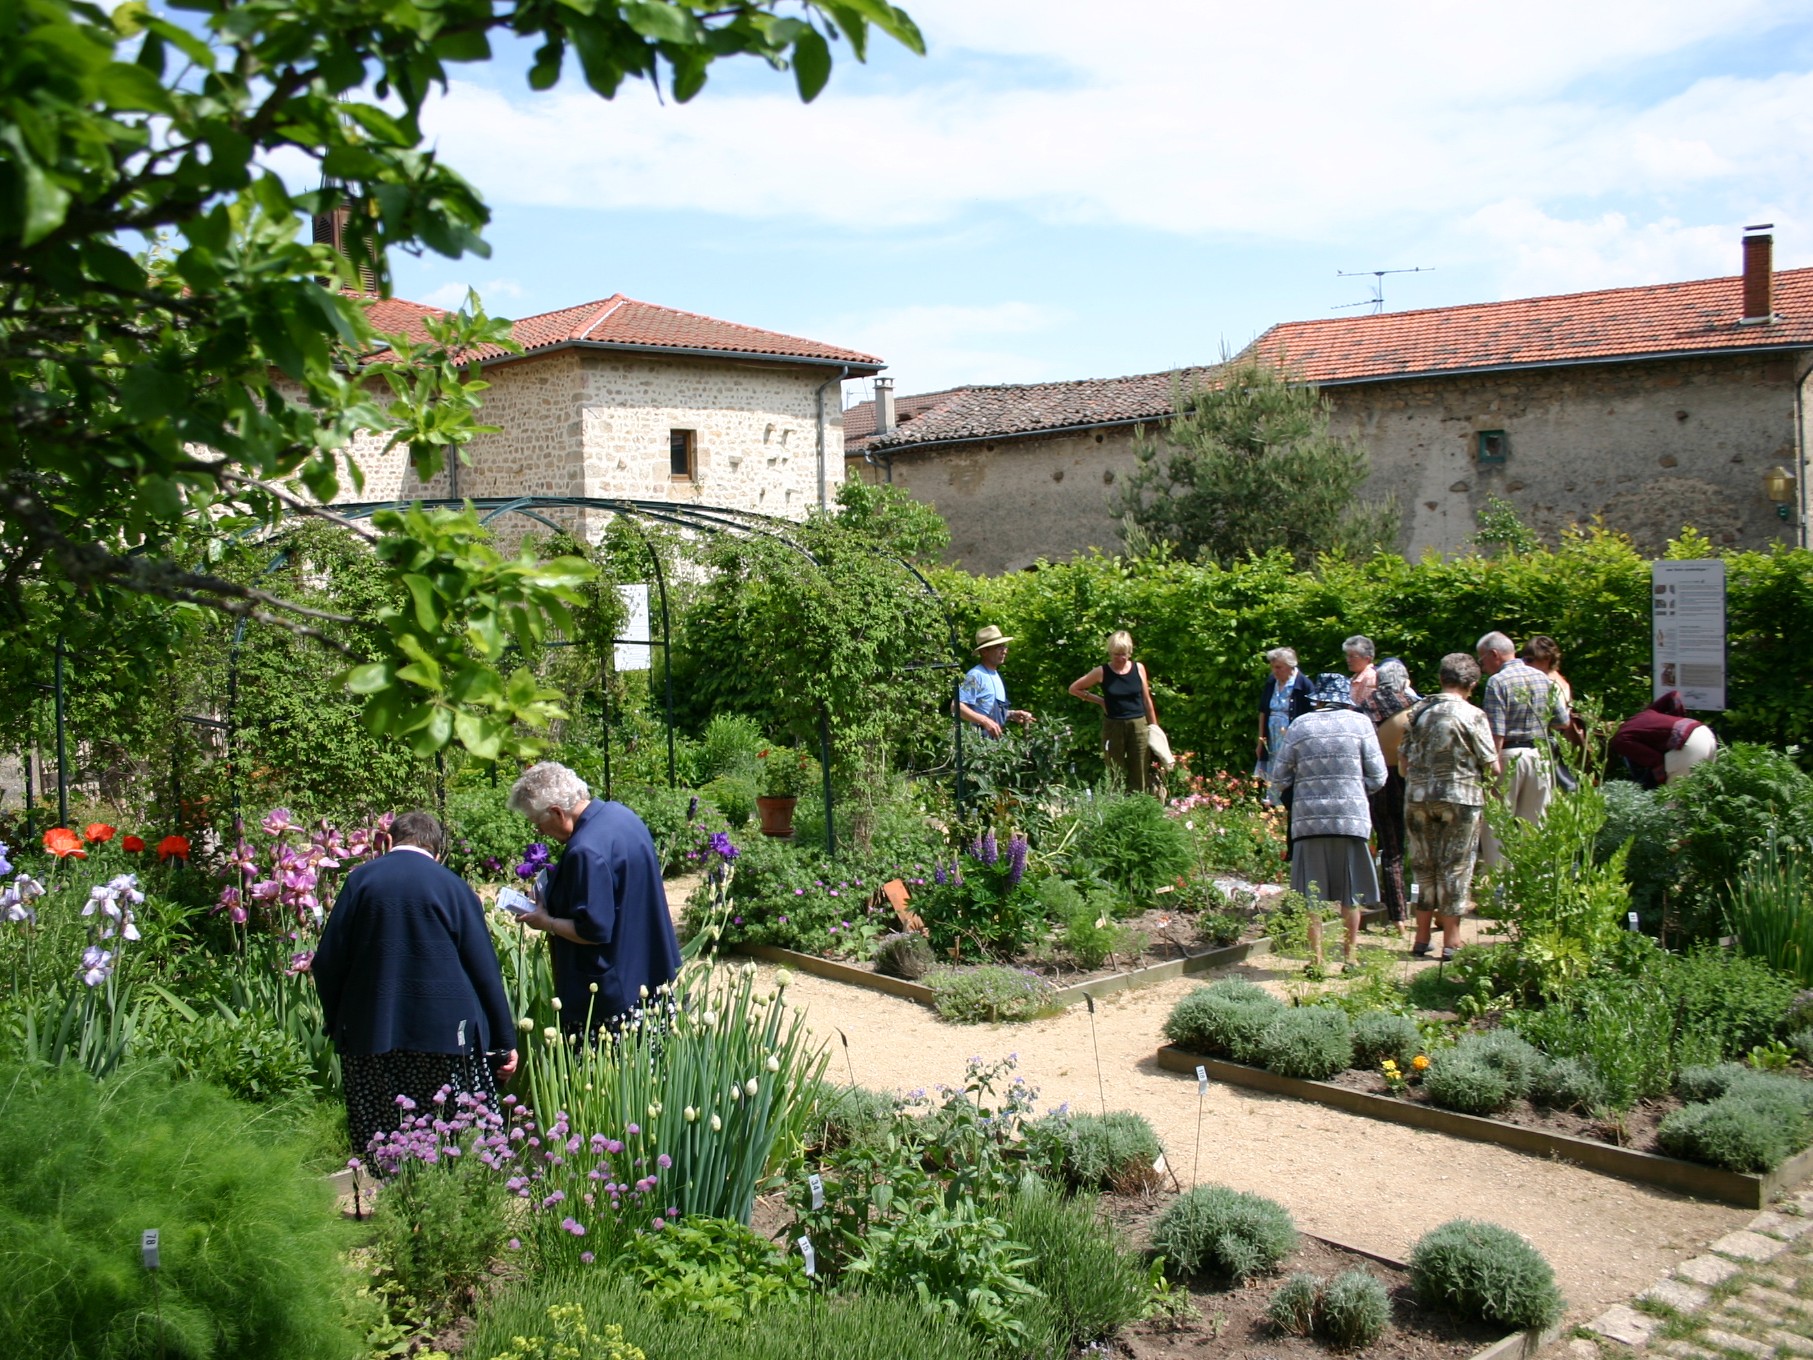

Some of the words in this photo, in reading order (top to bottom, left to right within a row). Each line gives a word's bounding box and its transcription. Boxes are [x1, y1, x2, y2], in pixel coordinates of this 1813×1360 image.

[811, 1180, 820, 1191] 34
[146, 1234, 156, 1245] 78
[801, 1241, 811, 1252] 15
